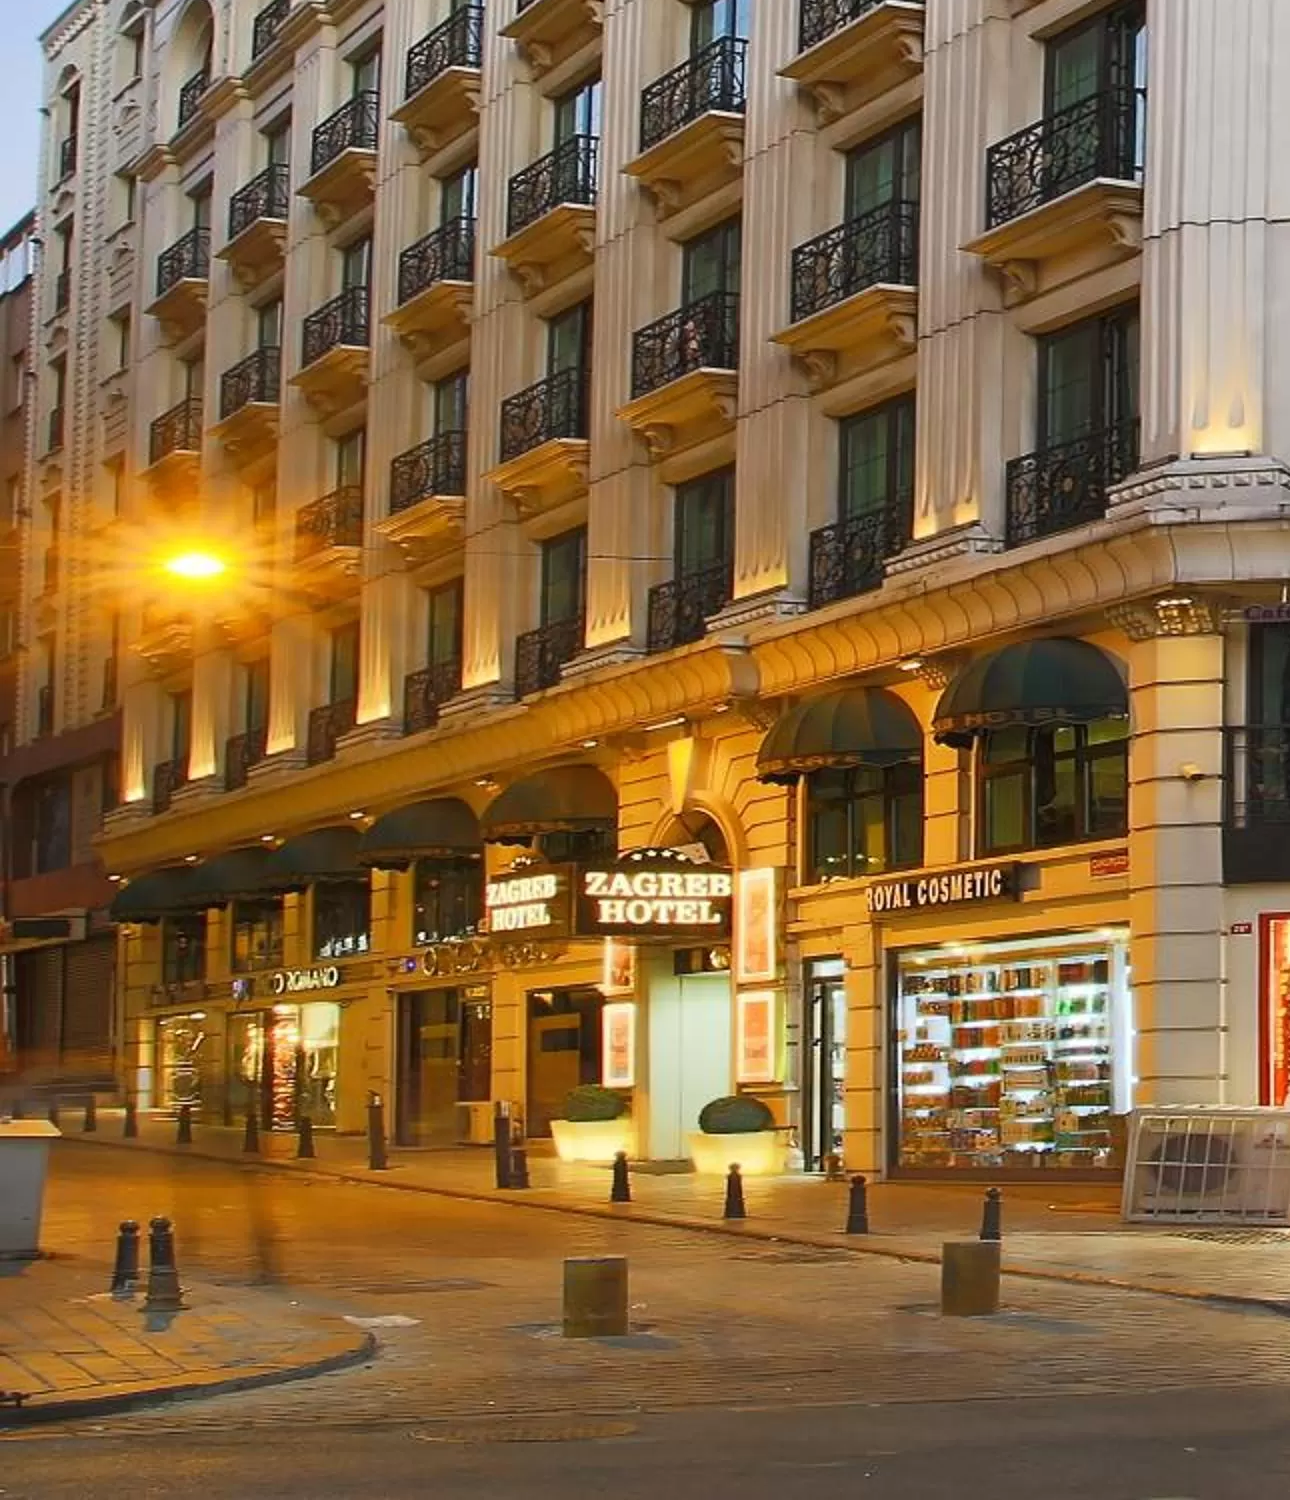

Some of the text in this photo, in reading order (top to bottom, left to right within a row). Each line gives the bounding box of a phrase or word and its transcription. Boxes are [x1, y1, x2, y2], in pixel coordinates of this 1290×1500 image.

[486, 874, 557, 907] ZAGREB
[584, 871, 732, 897] ZAGREB
[865, 869, 1002, 912] ROYAL COSMETIC
[491, 903, 551, 932] HOTEL
[597, 899, 722, 924] HOTEL
[286, 966, 339, 992] ROMANO
